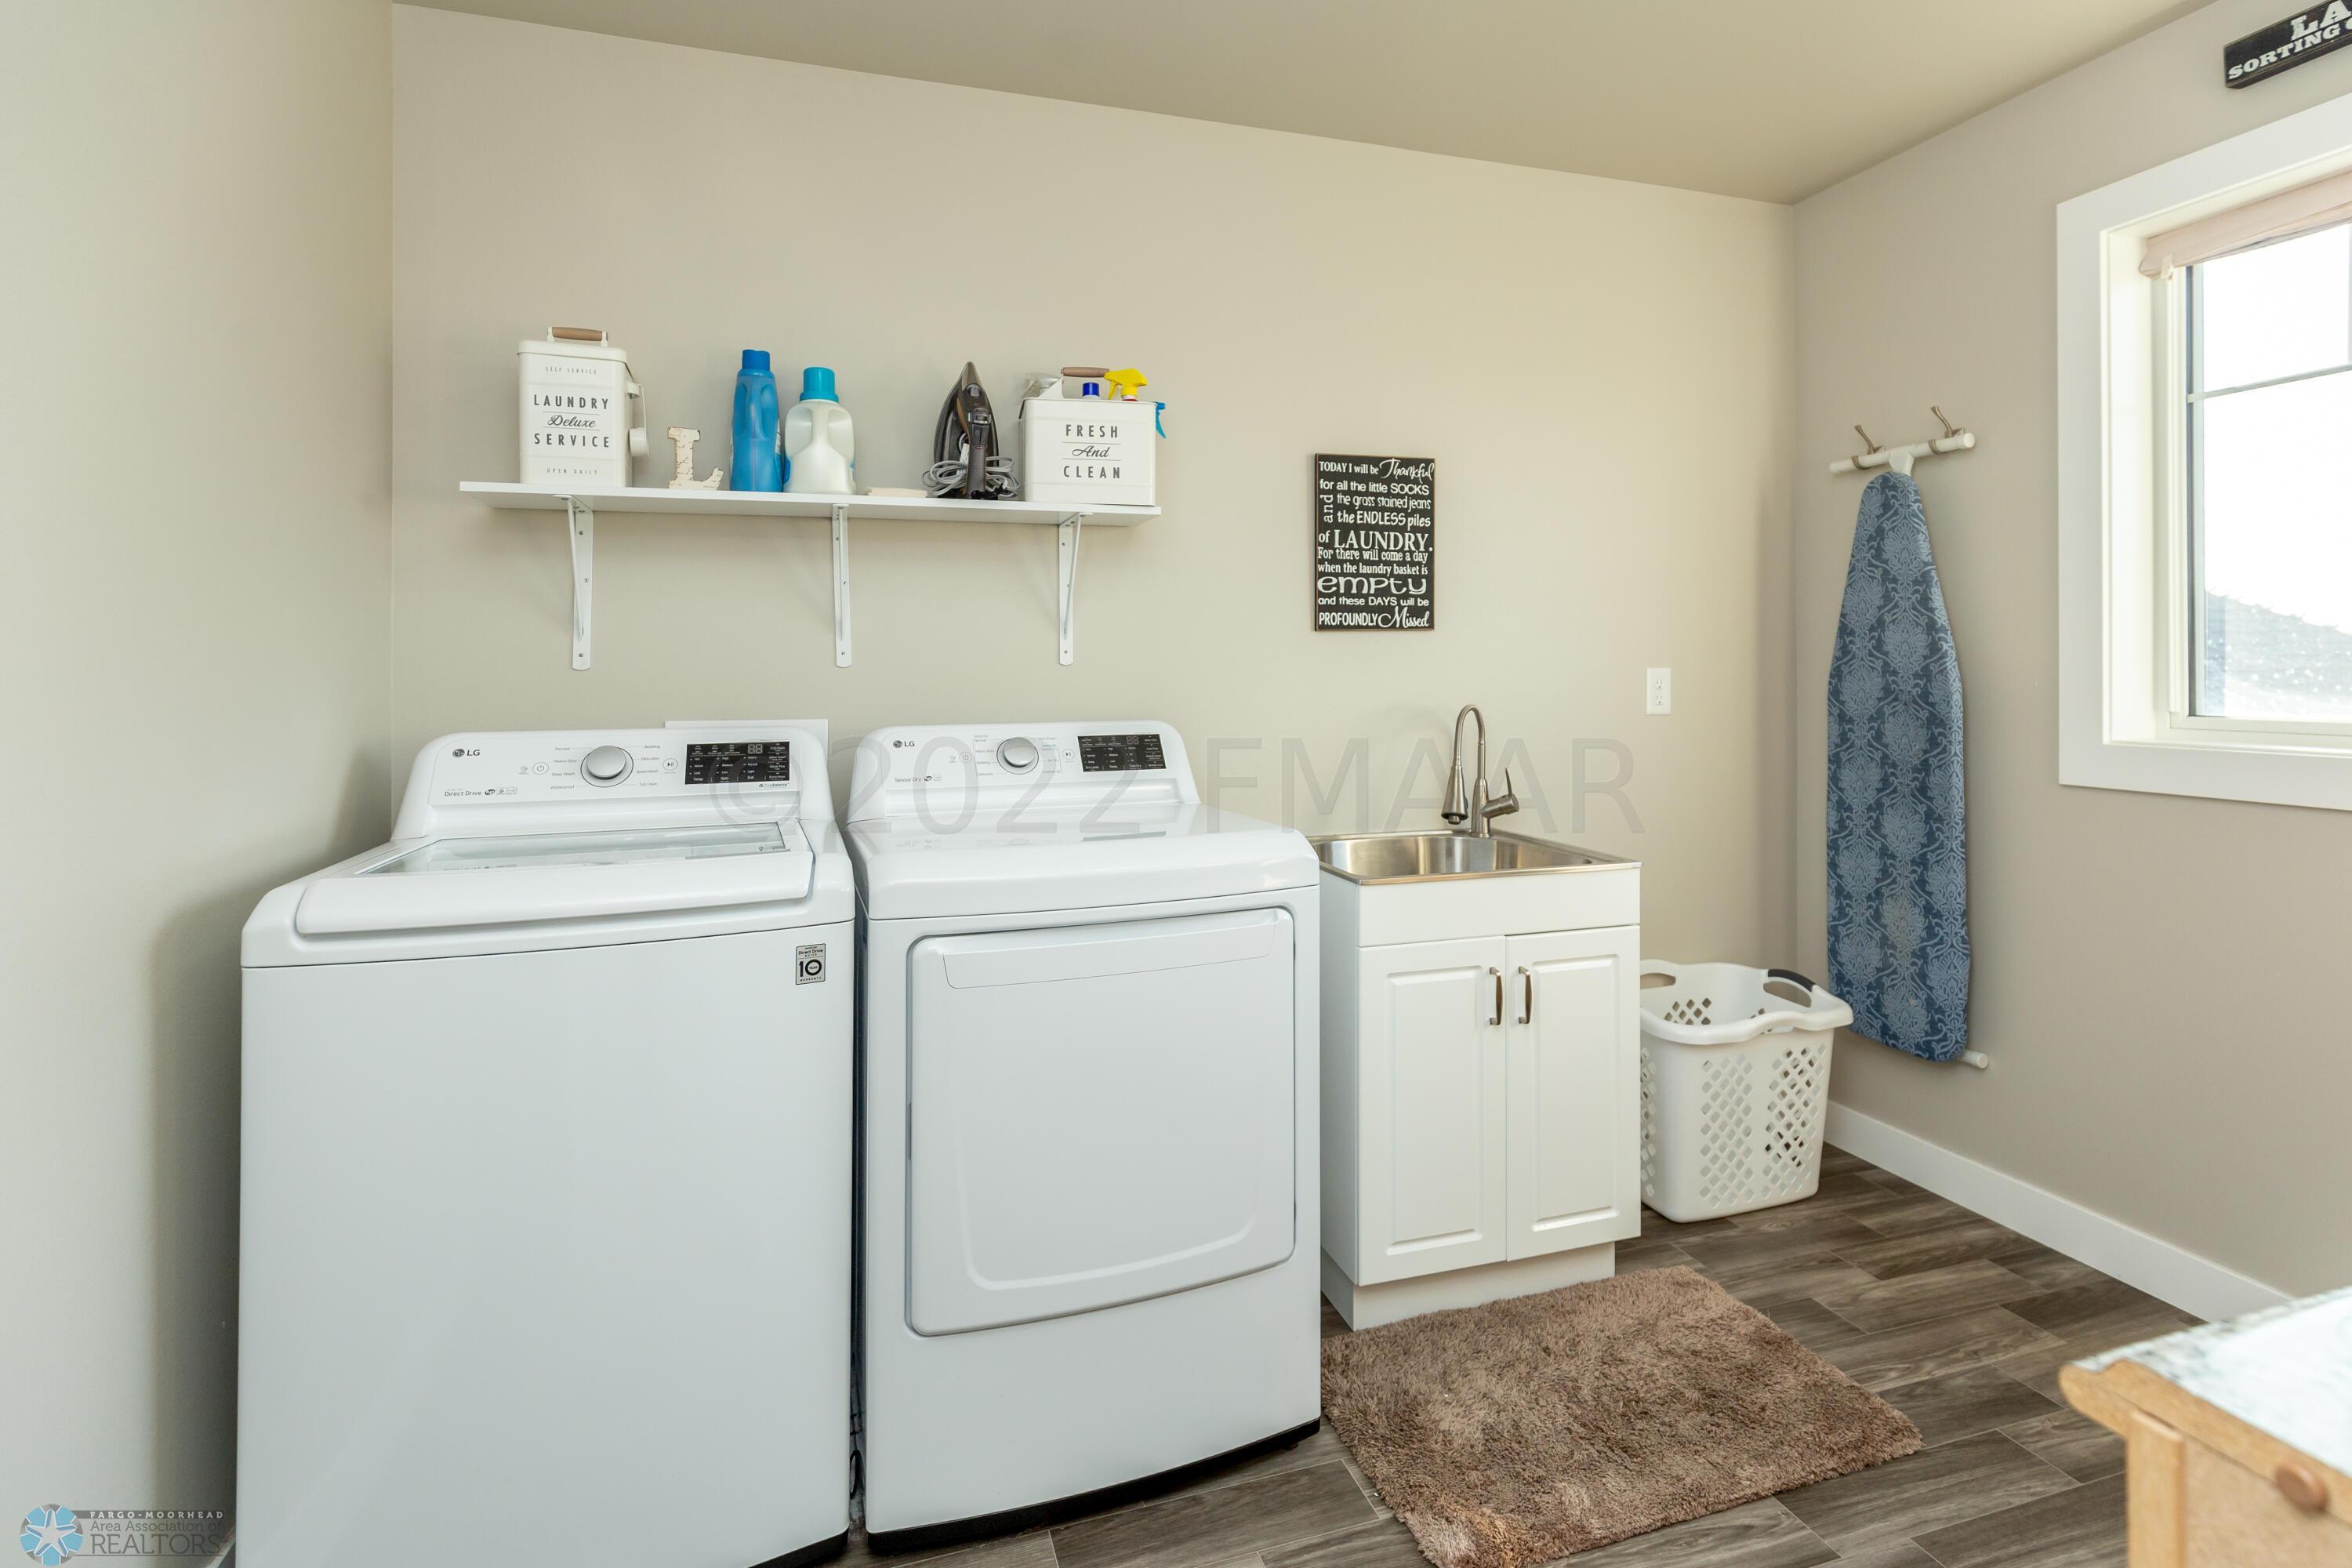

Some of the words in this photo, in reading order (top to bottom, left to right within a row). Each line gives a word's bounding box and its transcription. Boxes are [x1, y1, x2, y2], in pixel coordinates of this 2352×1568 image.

[2228, 23, 2340, 79] SORTING
[534, 394, 608, 409] LAUNDRY
[547, 415, 596, 428] Deluxe
[1065, 424, 1118, 438] FRESH
[534, 433, 609, 448] SERVICE
[1072, 445, 1110, 458] And
[1063, 466, 1120, 479] CLEAN
[1319, 461, 1347, 473] TODAY
[1349, 463, 1352, 474] I
[1354, 464, 1368, 474] will
[1370, 465, 1379, 475] be
[1379, 458, 1435, 484] Thankful
[1319, 478, 1334, 489] for
[1336, 480, 1348, 491] all
[1350, 481, 1366, 492] the
[1369, 481, 1388, 493] little
[1390, 483, 1429, 495] SOCKS
[1320, 494, 1334, 523] and
[1337, 492, 1350, 505] the
[1353, 495, 1375, 509] grass
[1377, 495, 1407, 508] stained
[1408, 496, 1432, 512] jeans
[1337, 510, 1355, 523] the
[1357, 510, 1406, 525] ENDLESS
[1408, 514, 1431, 531] piles
[1318, 530, 1330, 543] of
[1334, 529, 1433, 552] LAUNDRY.
[1317, 547, 1333, 559] For
[1336, 548, 1359, 560] there
[1363, 550, 1378, 561] will
[1381, 551, 1403, 561] come
[1405, 552, 1410, 561] a
[1413, 551, 1428, 564] day
[1318, 561, 1341, 573] when
[1343, 562, 1357, 573] the
[1359, 563, 1392, 576] laundry
[1394, 563, 1420, 575] basket
[1421, 564, 1428, 575] is
[1317, 575, 1427, 595] empty
[1318, 597, 1336, 605] and
[1339, 597, 1365, 605] these
[1369, 597, 1398, 606] DAYS
[1400, 597, 1414, 606] will
[1417, 597, 1429, 606] be
[1319, 612, 1378, 626] PROFOUNDLY
[1377, 605, 1430, 629] Missed
[799, 959, 822, 977] 10
